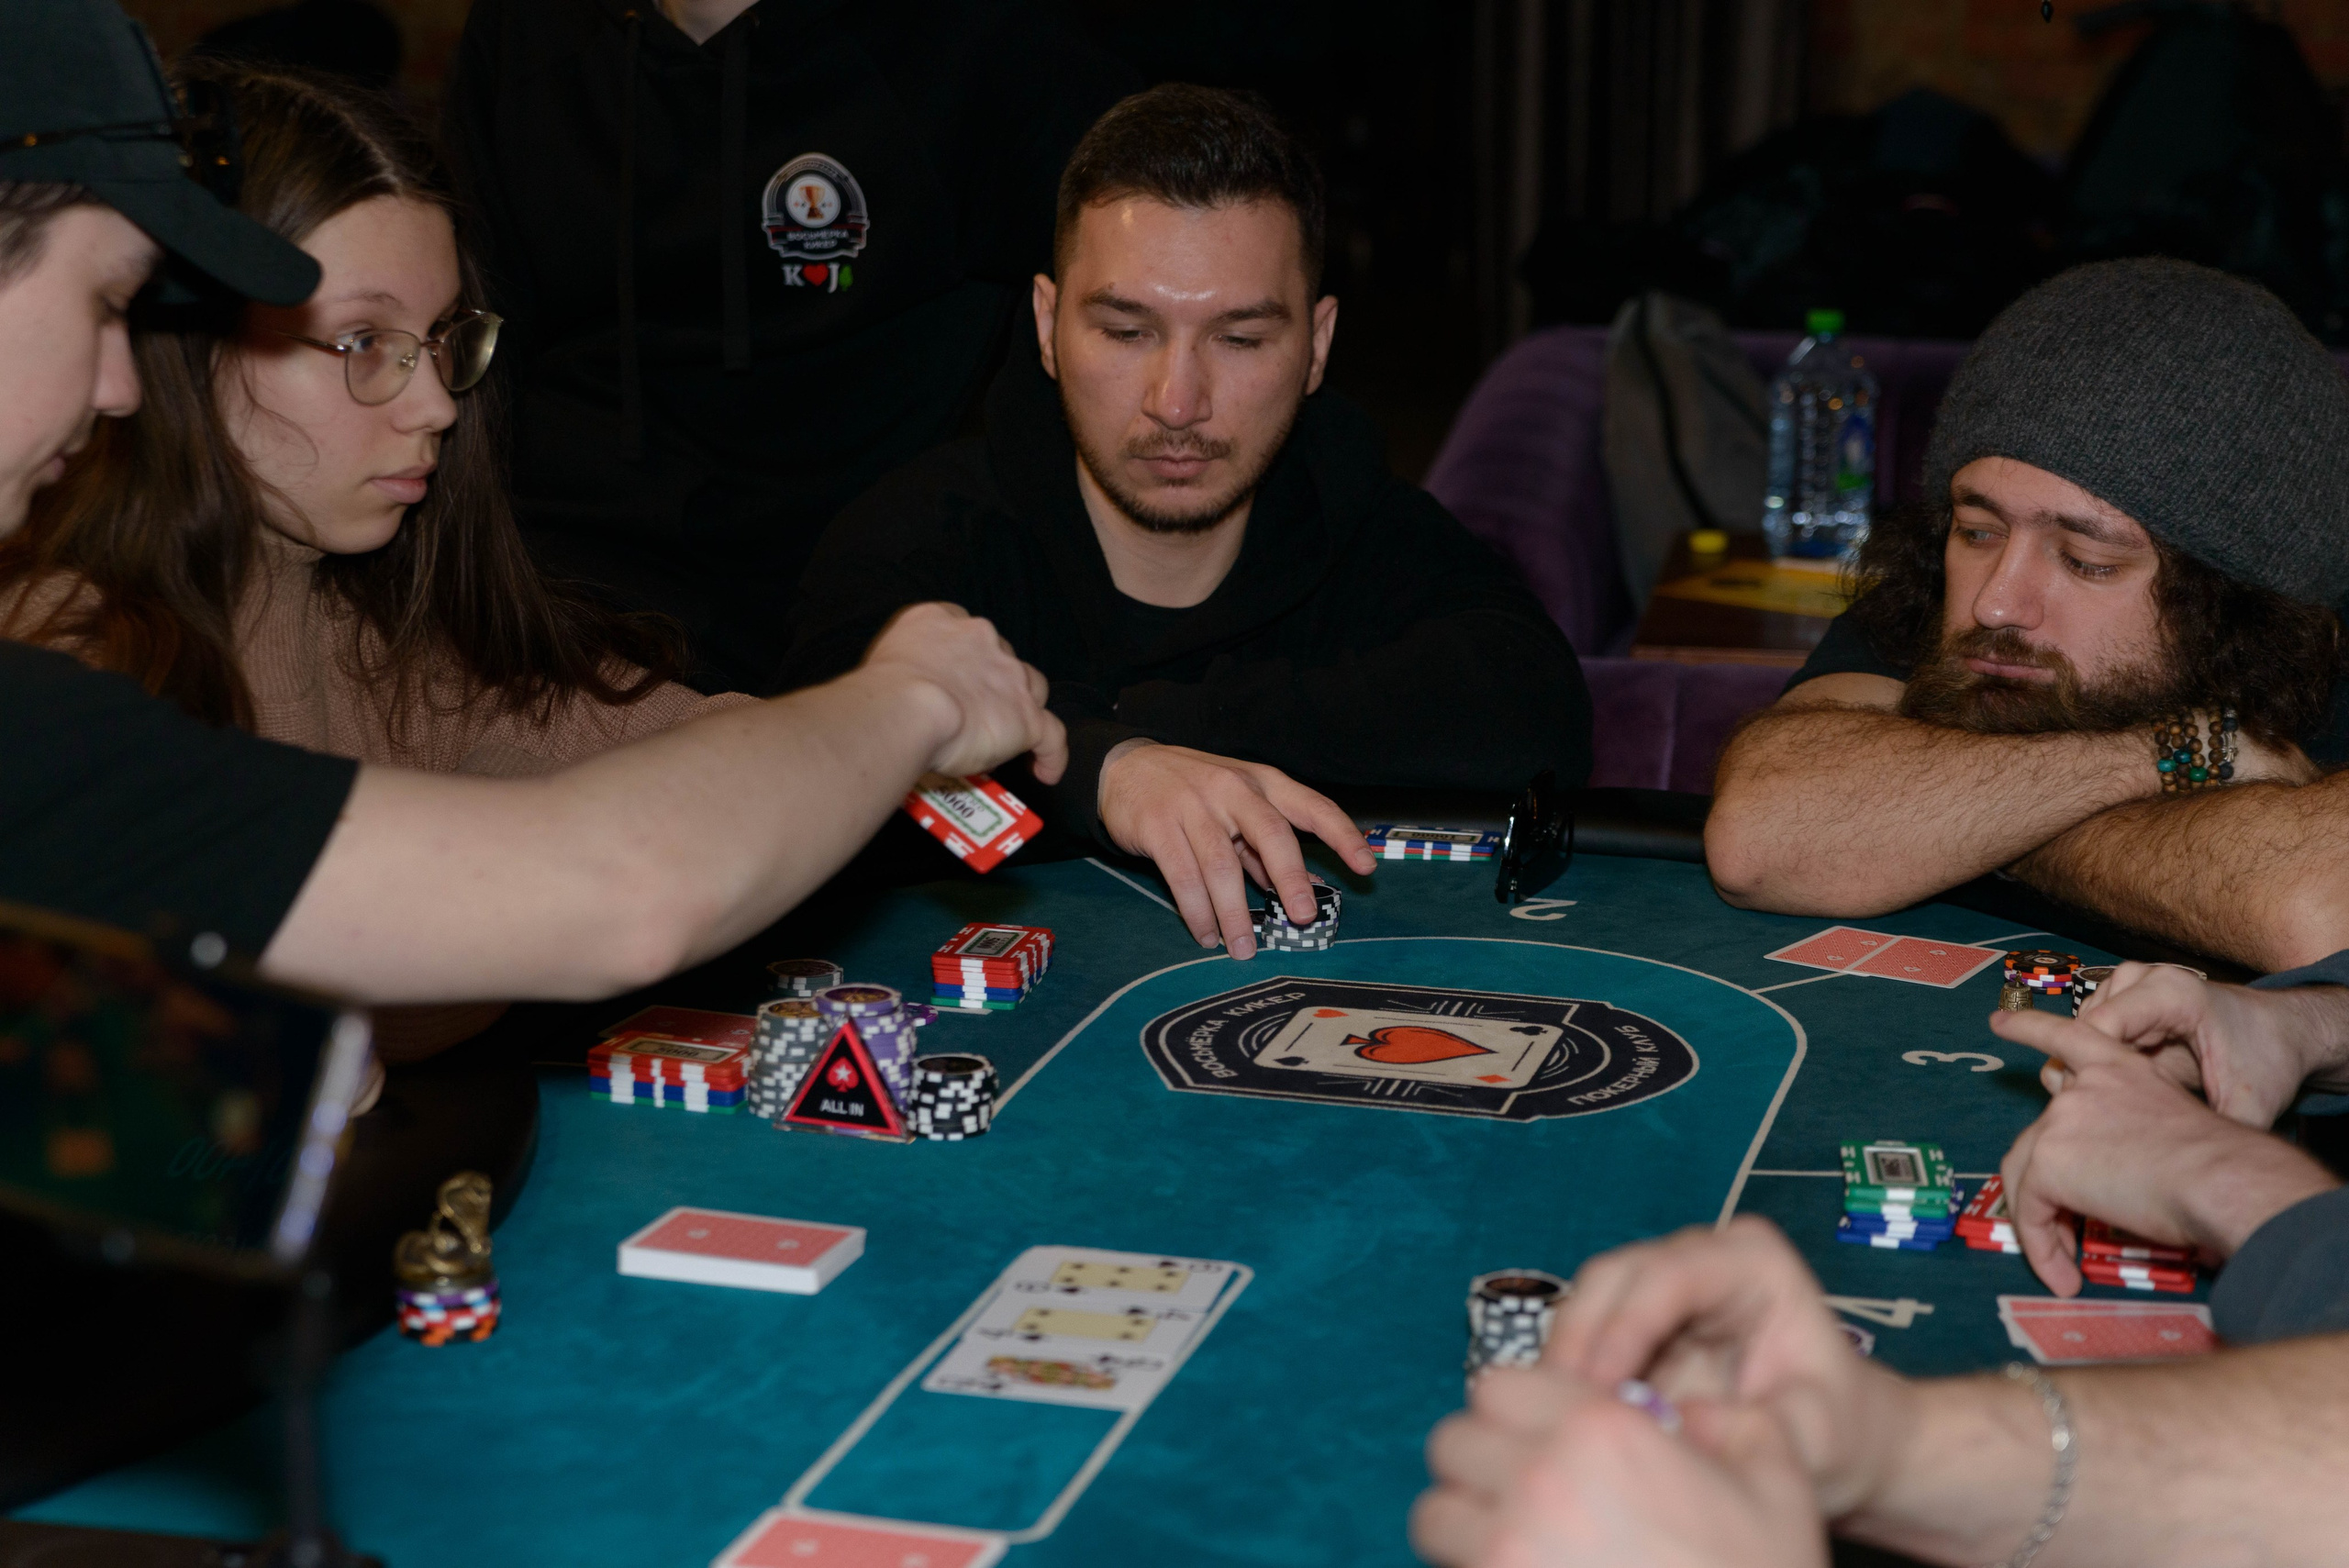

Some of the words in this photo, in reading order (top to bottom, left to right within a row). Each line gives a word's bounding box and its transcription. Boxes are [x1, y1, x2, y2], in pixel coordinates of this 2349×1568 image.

[936, 787, 975, 818] 000
[1509, 895, 1577, 920] 2
[1222, 993, 1306, 1017] КИКЕР
[1567, 1057, 1661, 1105] ПОКЕРНЫЙ
[1614, 1025, 1659, 1051] КЛУБ
[1901, 1051, 2005, 1072] 3
[819, 1098, 848, 1115] ALL
[849, 1102, 864, 1117] IN
[1820, 1295, 1935, 1329] 4
